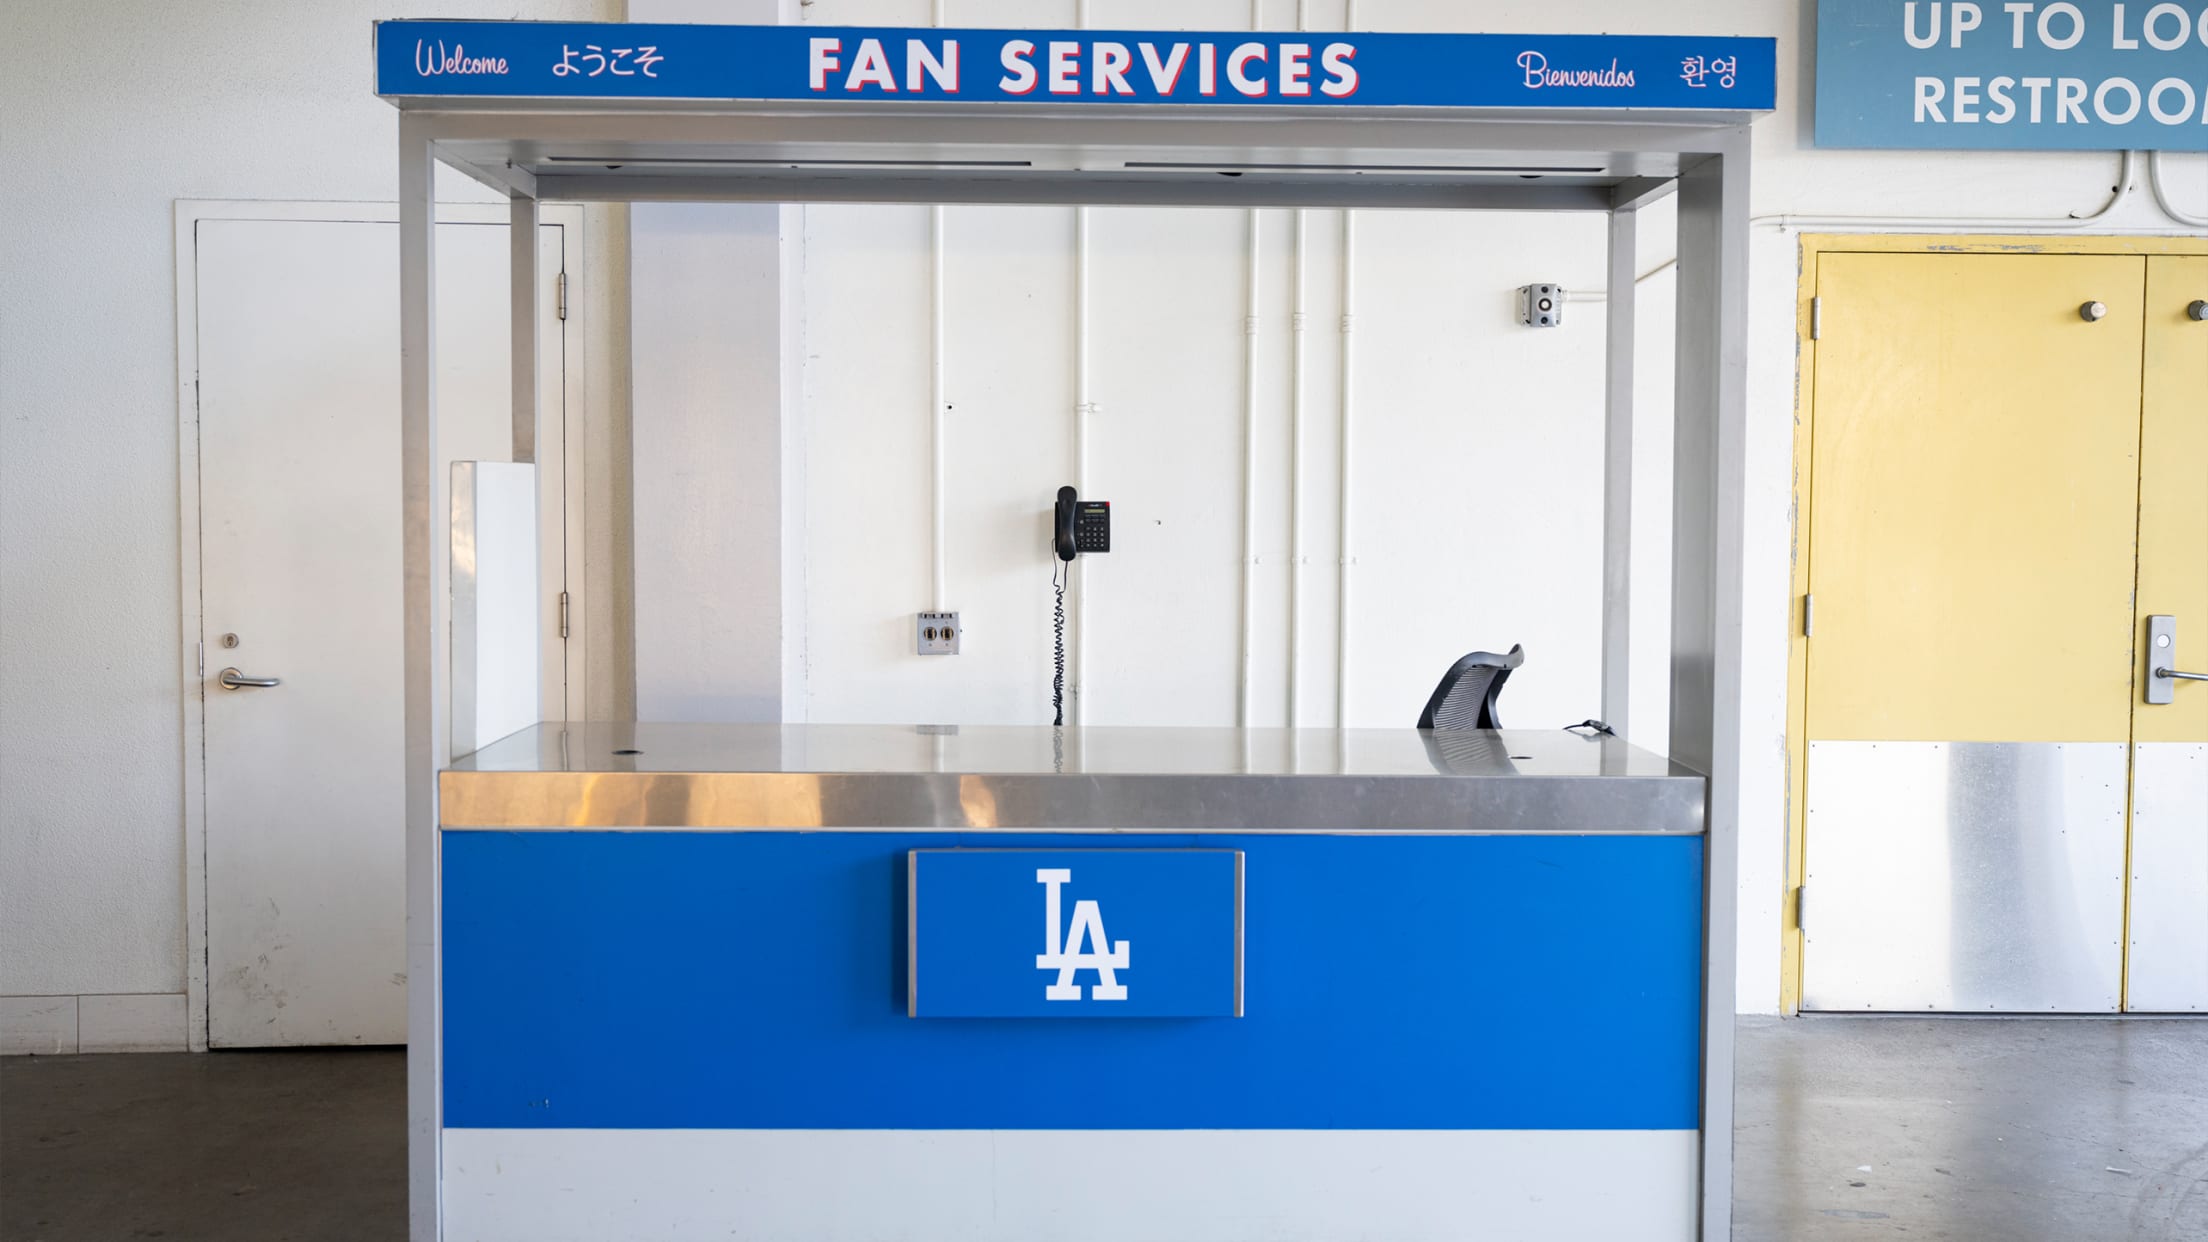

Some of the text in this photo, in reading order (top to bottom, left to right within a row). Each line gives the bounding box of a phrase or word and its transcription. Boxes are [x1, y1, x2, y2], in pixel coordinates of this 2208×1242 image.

[1903, 1, 2208, 52] UP TO LO
[415, 38, 510, 78] Welcome
[551, 43, 665, 79] ようこそ
[808, 36, 1361, 99] FAN SERVICES
[1516, 49, 1637, 89] Bienvenidos
[1679, 54, 1738, 90] 환영
[1913, 75, 2208, 126] RESTROO
[1035, 867, 1131, 1002] LA
